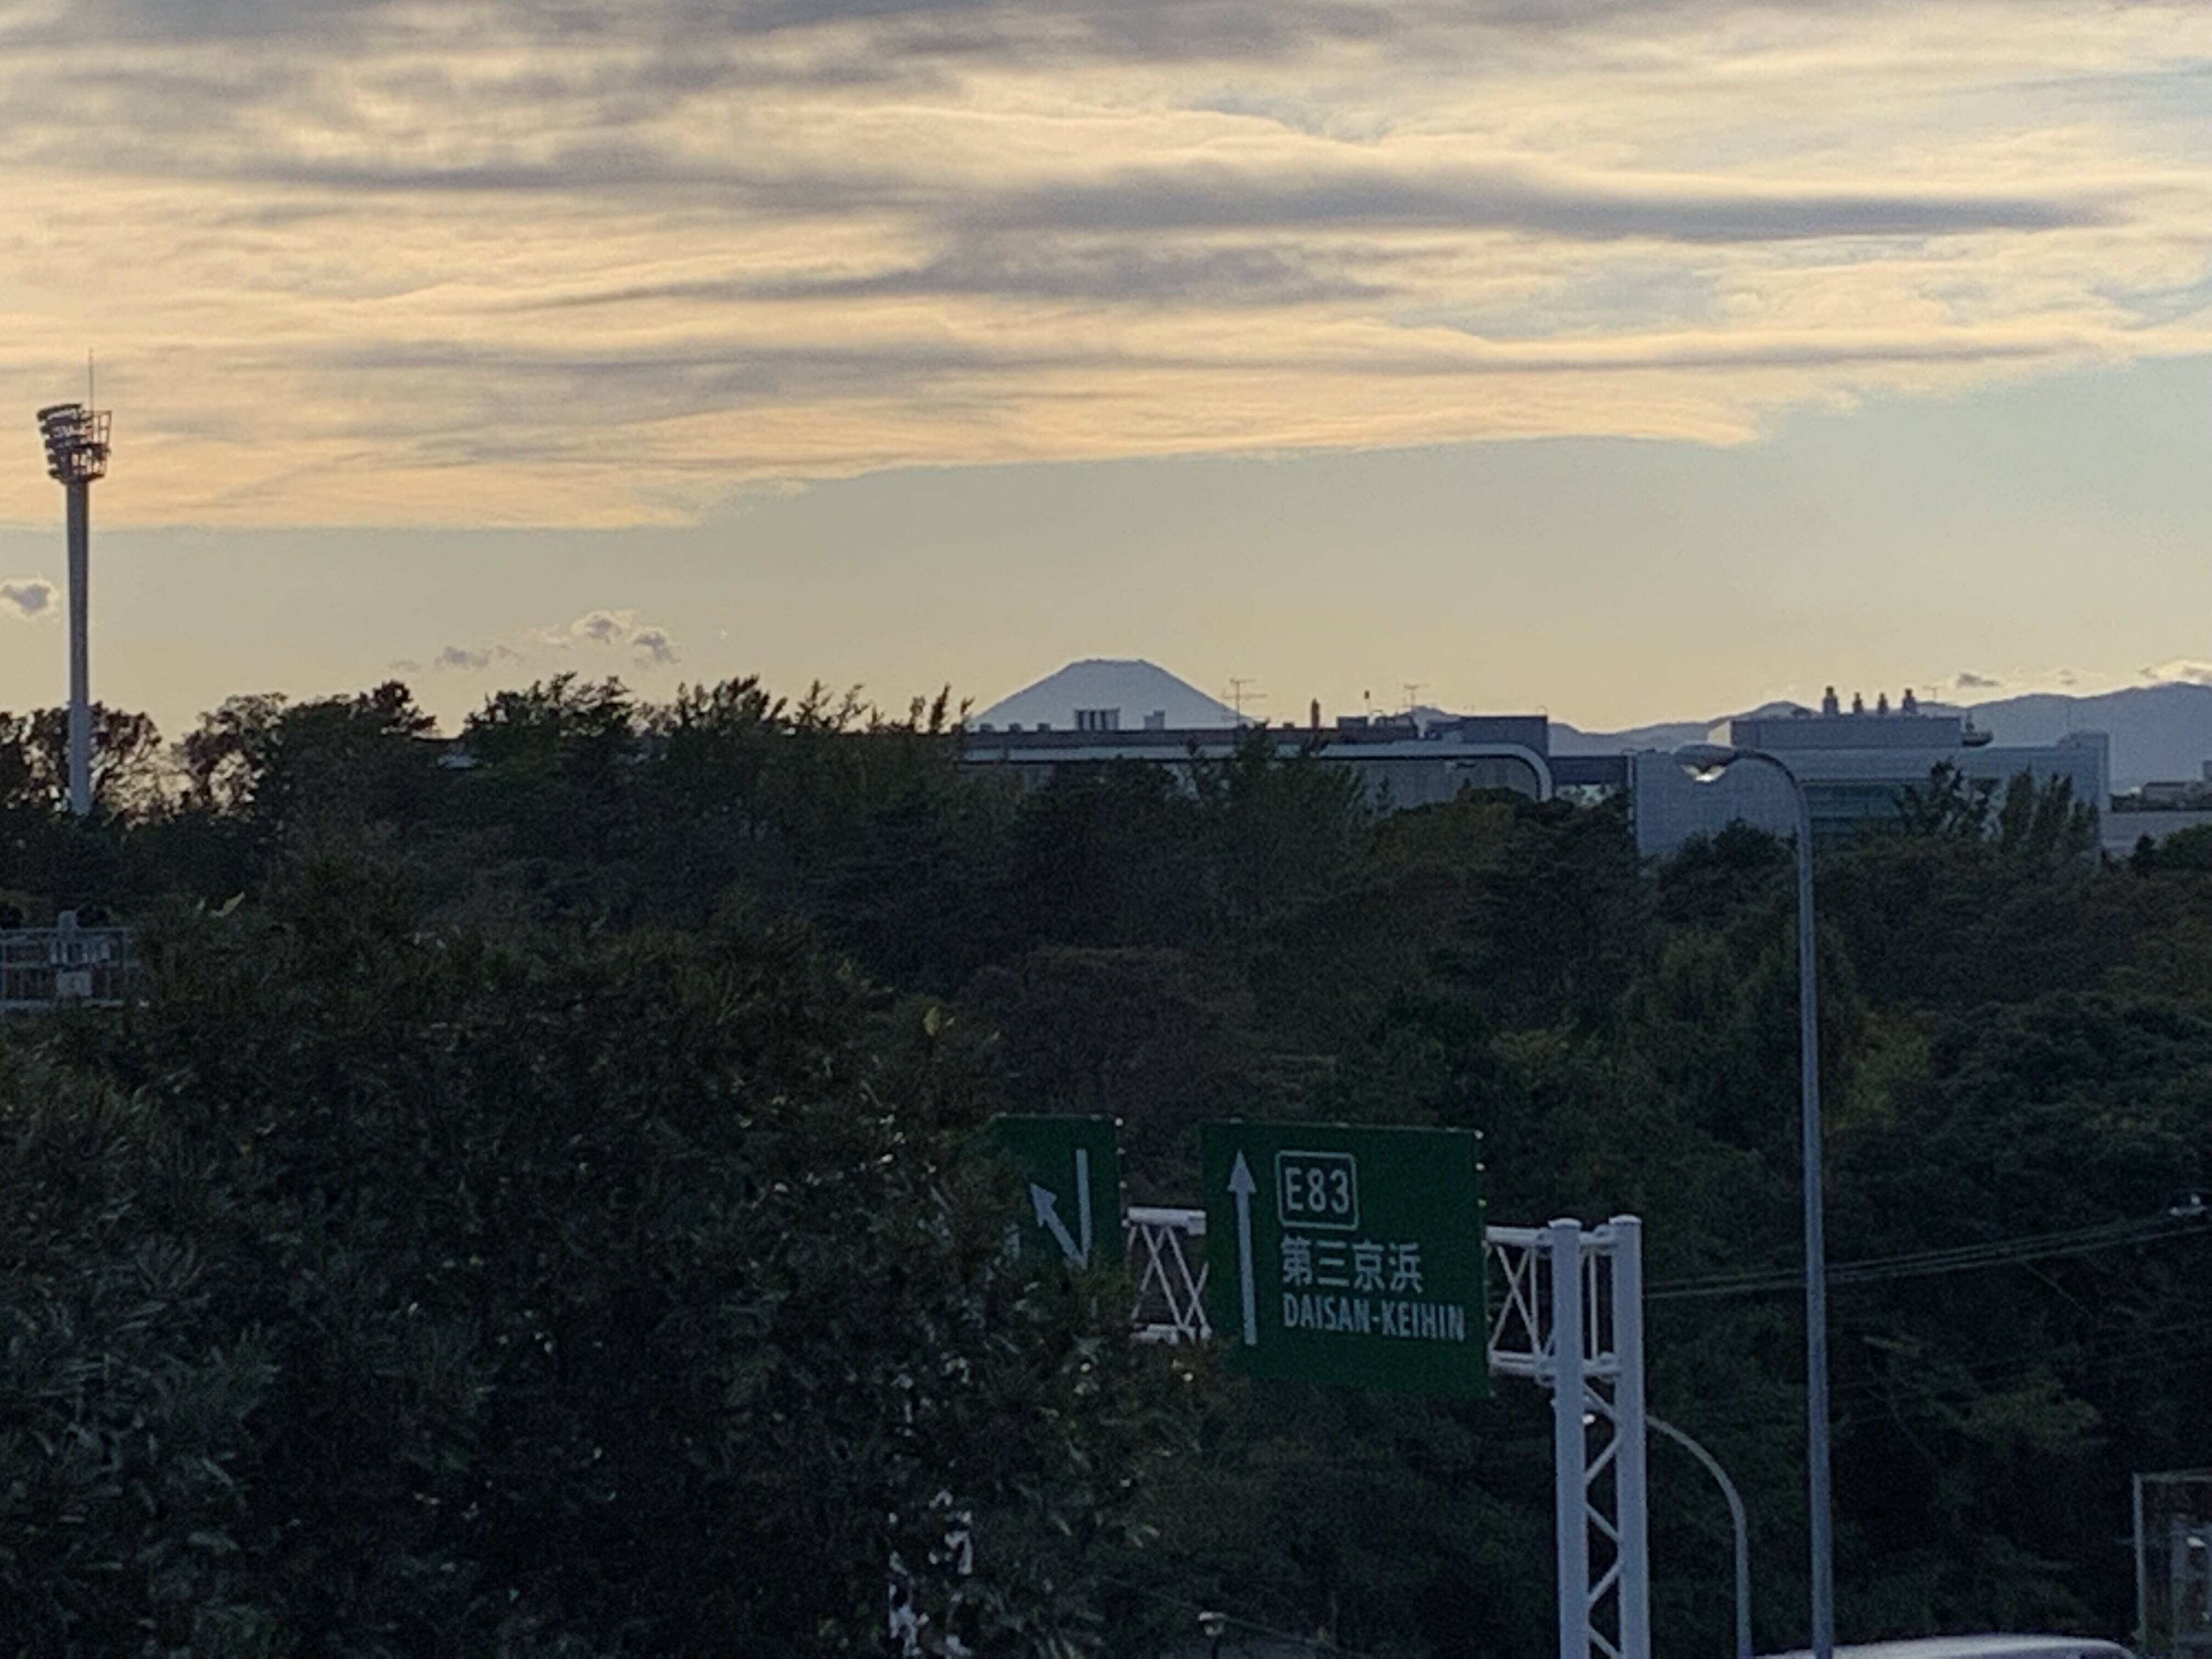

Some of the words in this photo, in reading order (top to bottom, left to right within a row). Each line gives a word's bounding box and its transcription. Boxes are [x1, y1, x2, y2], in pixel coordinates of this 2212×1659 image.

[1284, 1167, 1350, 1214] E83
[1280, 1233, 1423, 1293] 第三京浜
[1283, 1293, 1465, 1342] DAISAN-KEIHIN
